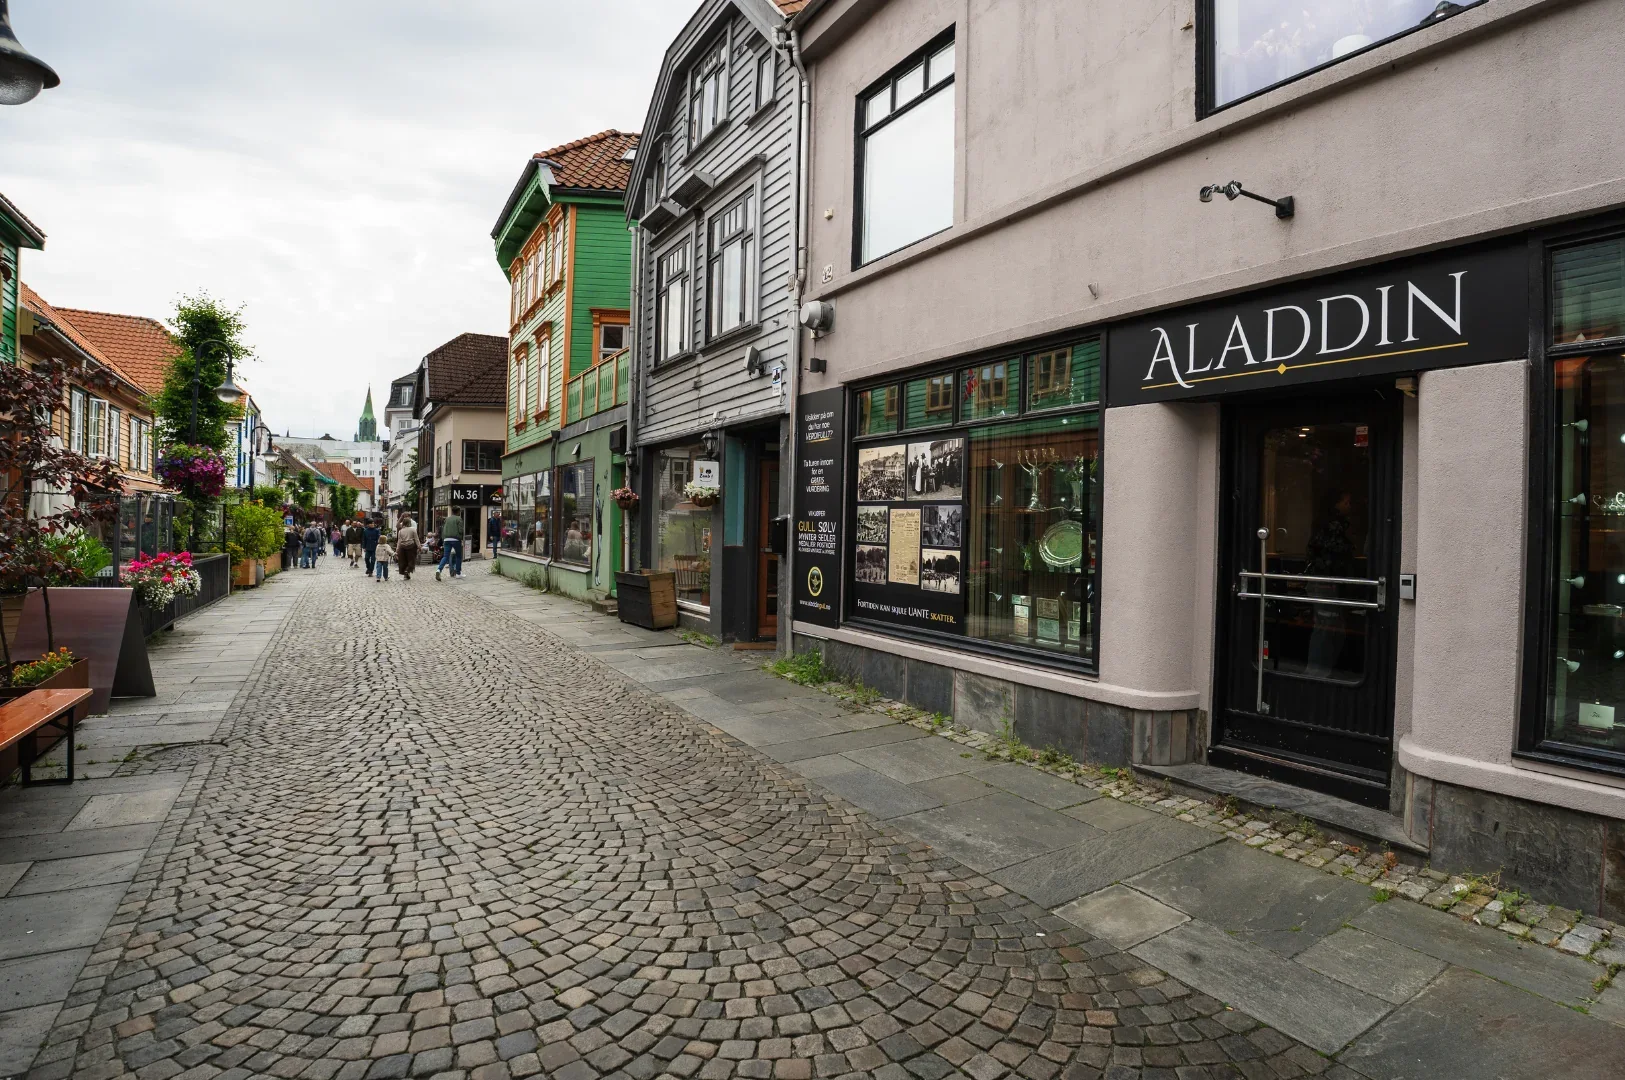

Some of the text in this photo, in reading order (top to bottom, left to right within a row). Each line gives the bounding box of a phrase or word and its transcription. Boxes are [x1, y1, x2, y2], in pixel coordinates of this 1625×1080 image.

[1142, 270, 1468, 389] ALADDIN
[820, 412, 827, 421] på
[826, 410, 834, 418] om
[822, 421, 830, 429] noe
[809, 459, 820, 467] turen
[820, 458, 834, 466] innom
[806, 485, 830, 493] VURDERING
[466, 490, 478, 500] 36
[798, 521, 837, 533] GULL SØLV
[798, 533, 836, 542] MYNTER SEDLER
[908, 606, 930, 619] UANTE
[930, 612, 957, 624] SKATTER.
